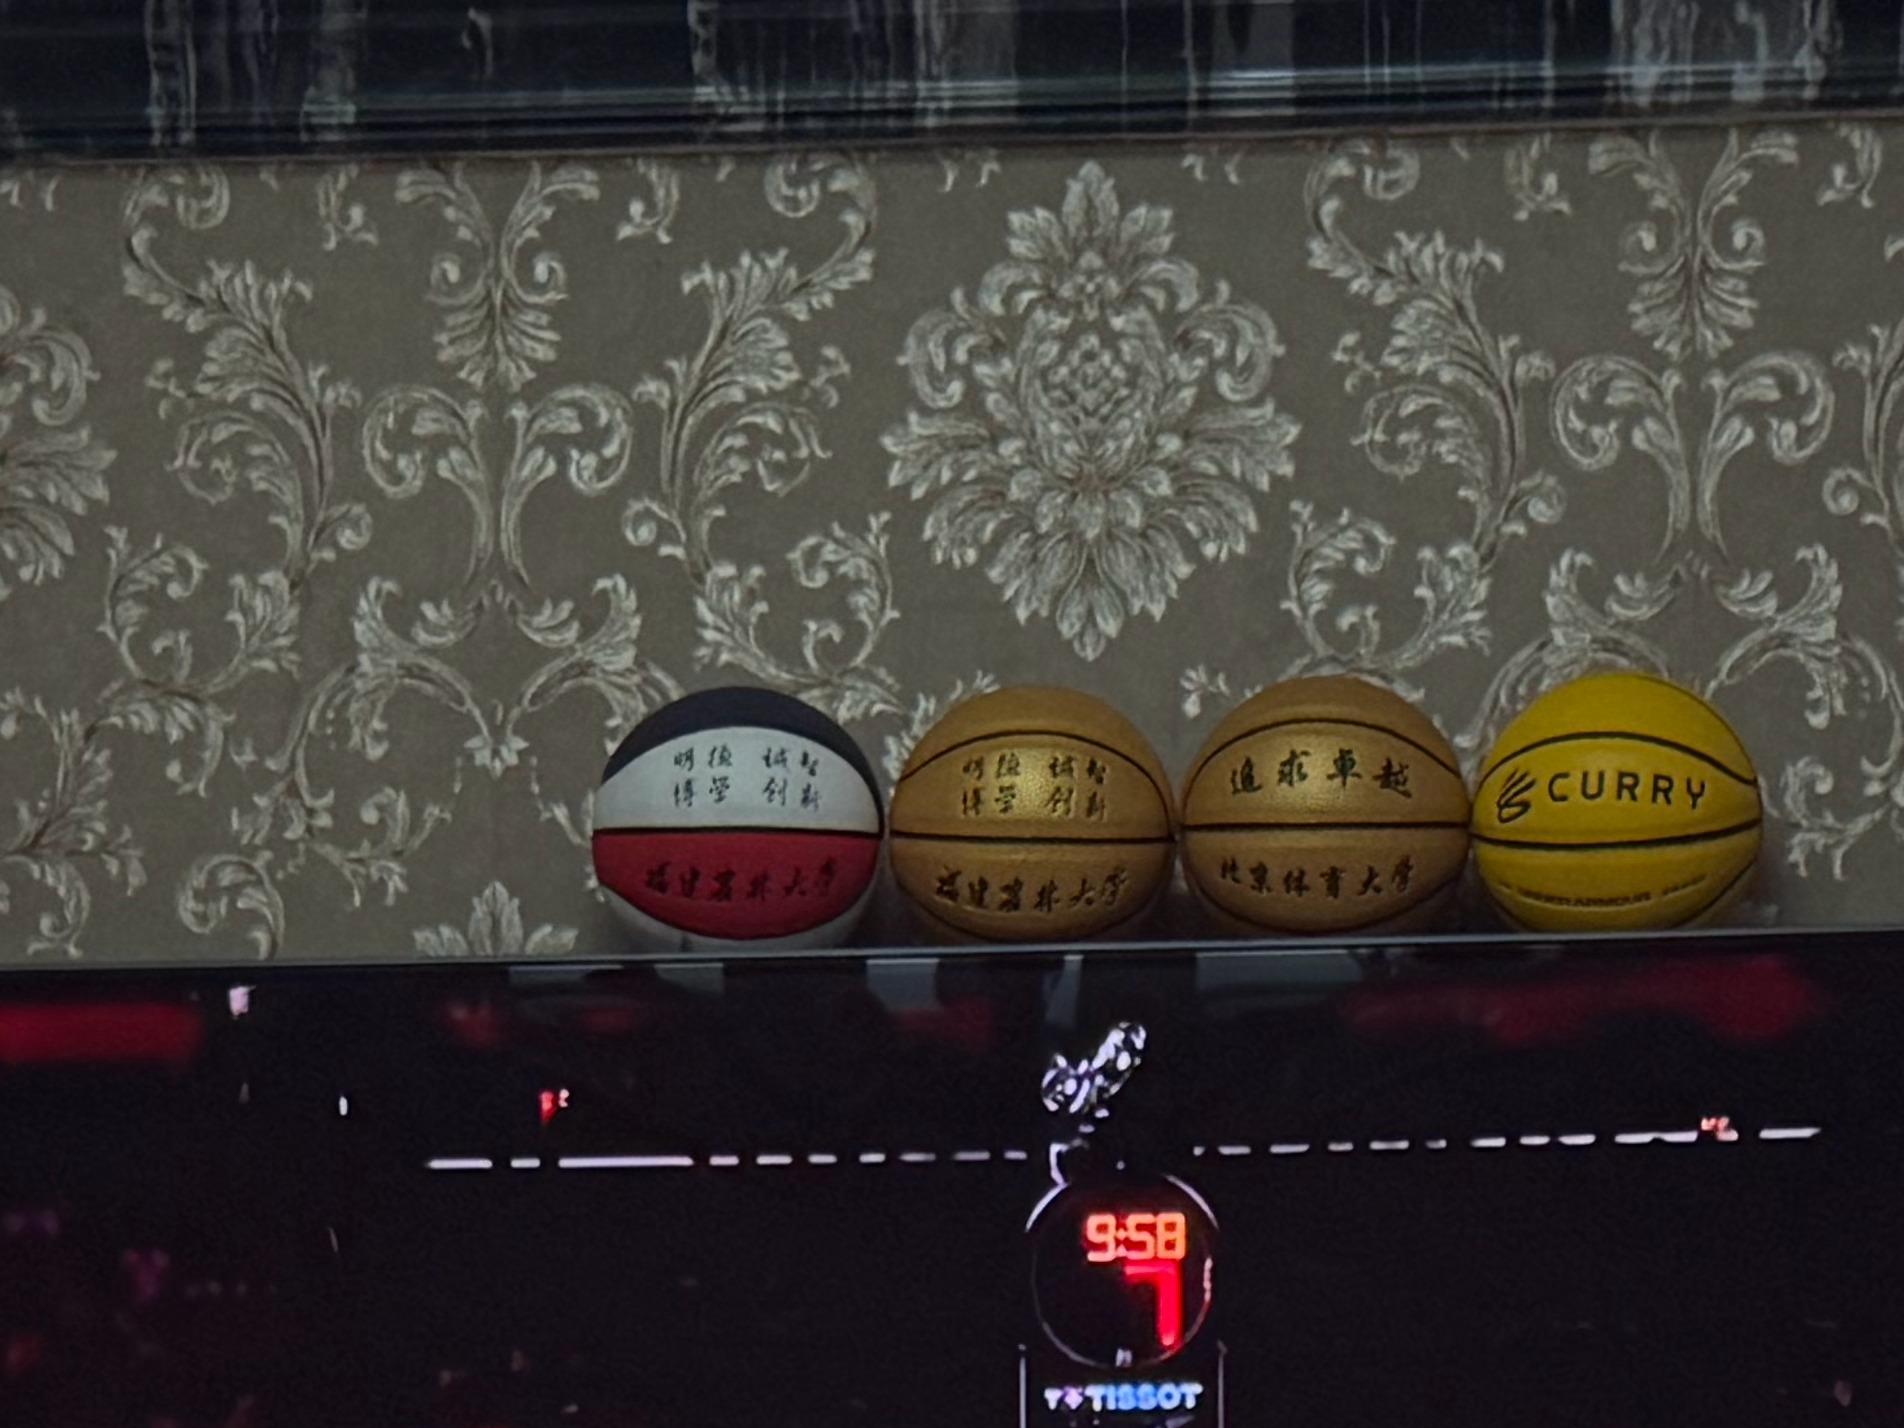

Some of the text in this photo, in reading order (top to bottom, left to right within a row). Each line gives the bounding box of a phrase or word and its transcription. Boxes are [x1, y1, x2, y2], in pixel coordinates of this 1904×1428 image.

[1547, 770, 1707, 810] CURRY
[1085, 1212, 1187, 1262] 9:58
[1124, 1261, 1181, 1347] 7
